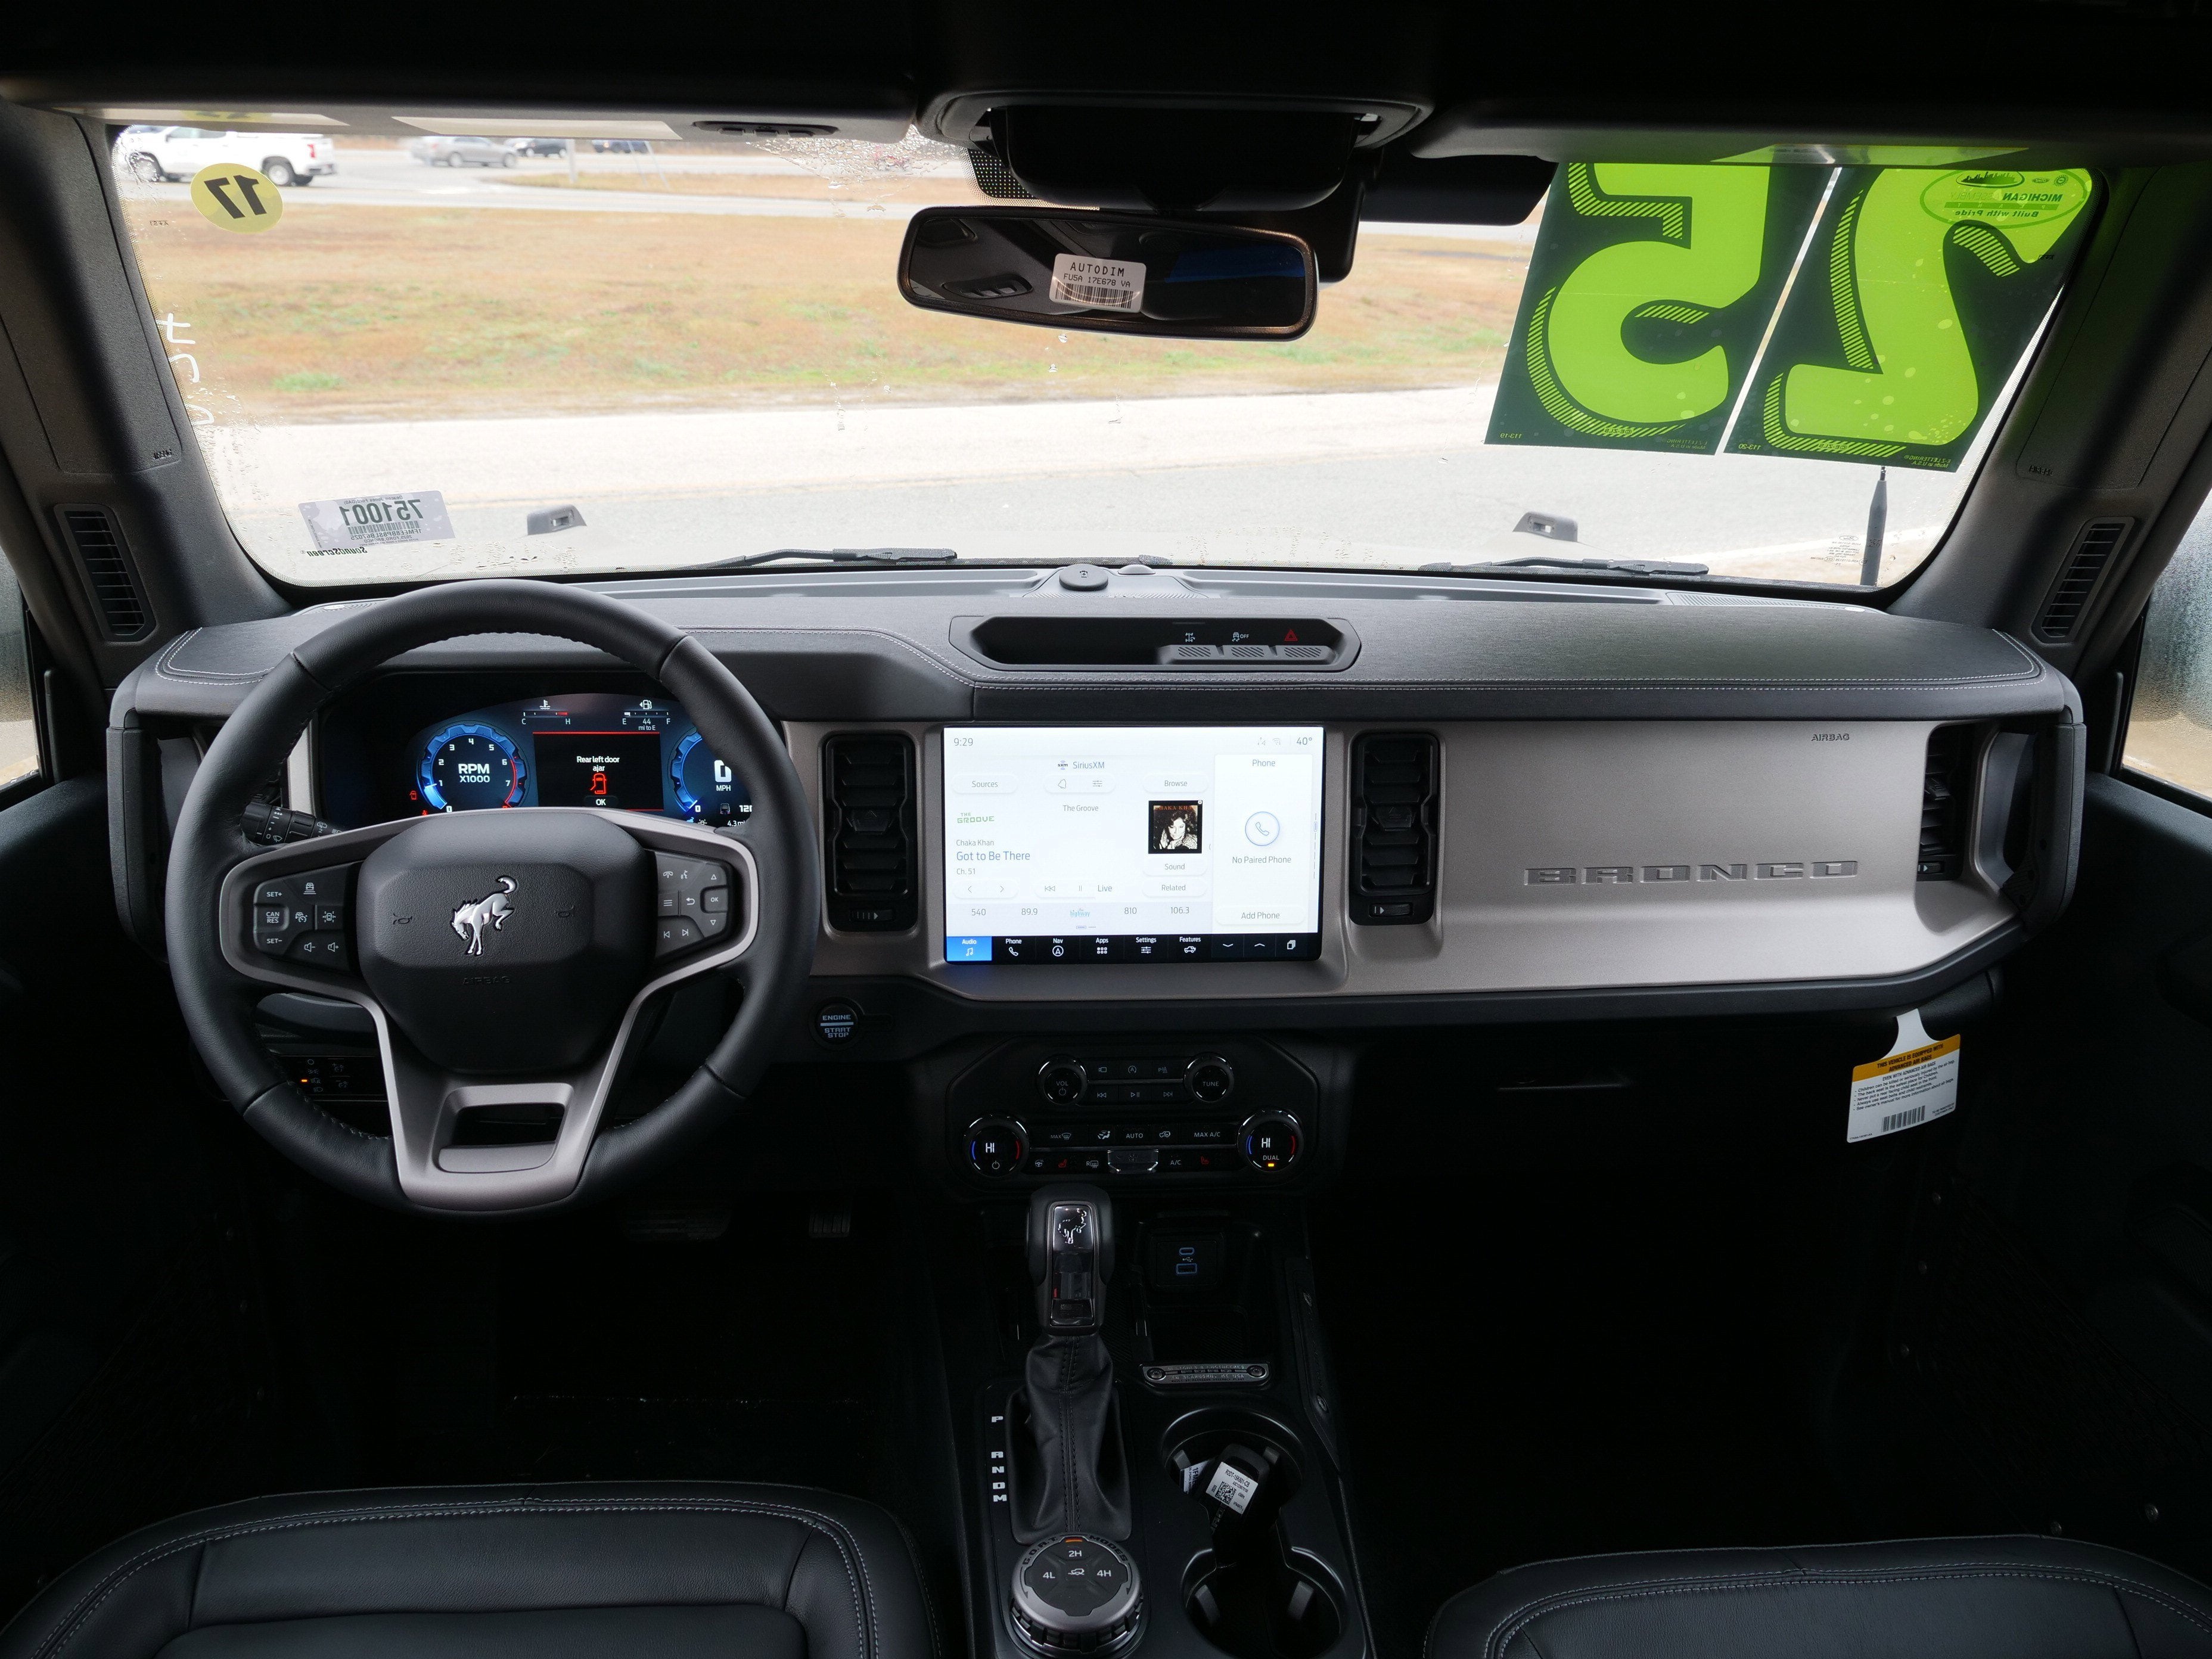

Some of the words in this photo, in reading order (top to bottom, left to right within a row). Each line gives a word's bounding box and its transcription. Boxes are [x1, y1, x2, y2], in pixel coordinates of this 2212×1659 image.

[1070, 262, 1124, 277] AUTODIM
[1063, 273, 1083, 281] FU5A
[1088, 276, 1116, 285] 17E678
[1297, 737, 1313, 746] 40°
[1811, 732, 1850, 741] AIRBAG
[953, 738, 973, 747] 9:29
[458, 764, 490, 773] RPM
[1073, 761, 1105, 770] SiriusXM
[957, 815, 995, 824] GROOVE
[956, 852, 973, 861] Got
[975, 853, 986, 861] to
[988, 852, 1001, 861] Be
[1003, 852, 1030, 861] There
[1523, 860, 1858, 886] BRONCO
[463, 975, 511, 986] AIRBAG
[1888, 1057, 1905, 1065] VEHICLE
[1912, 1048, 1932, 1058] EQUIPPED
[1889, 1061, 1912, 1071] ADVANCED
[1912, 1088, 1931, 1096] information
[986, 1142, 995, 1152] HI
[1261, 1138, 1271, 1148] HI
[1089, 1535, 1128, 1562] MODES
